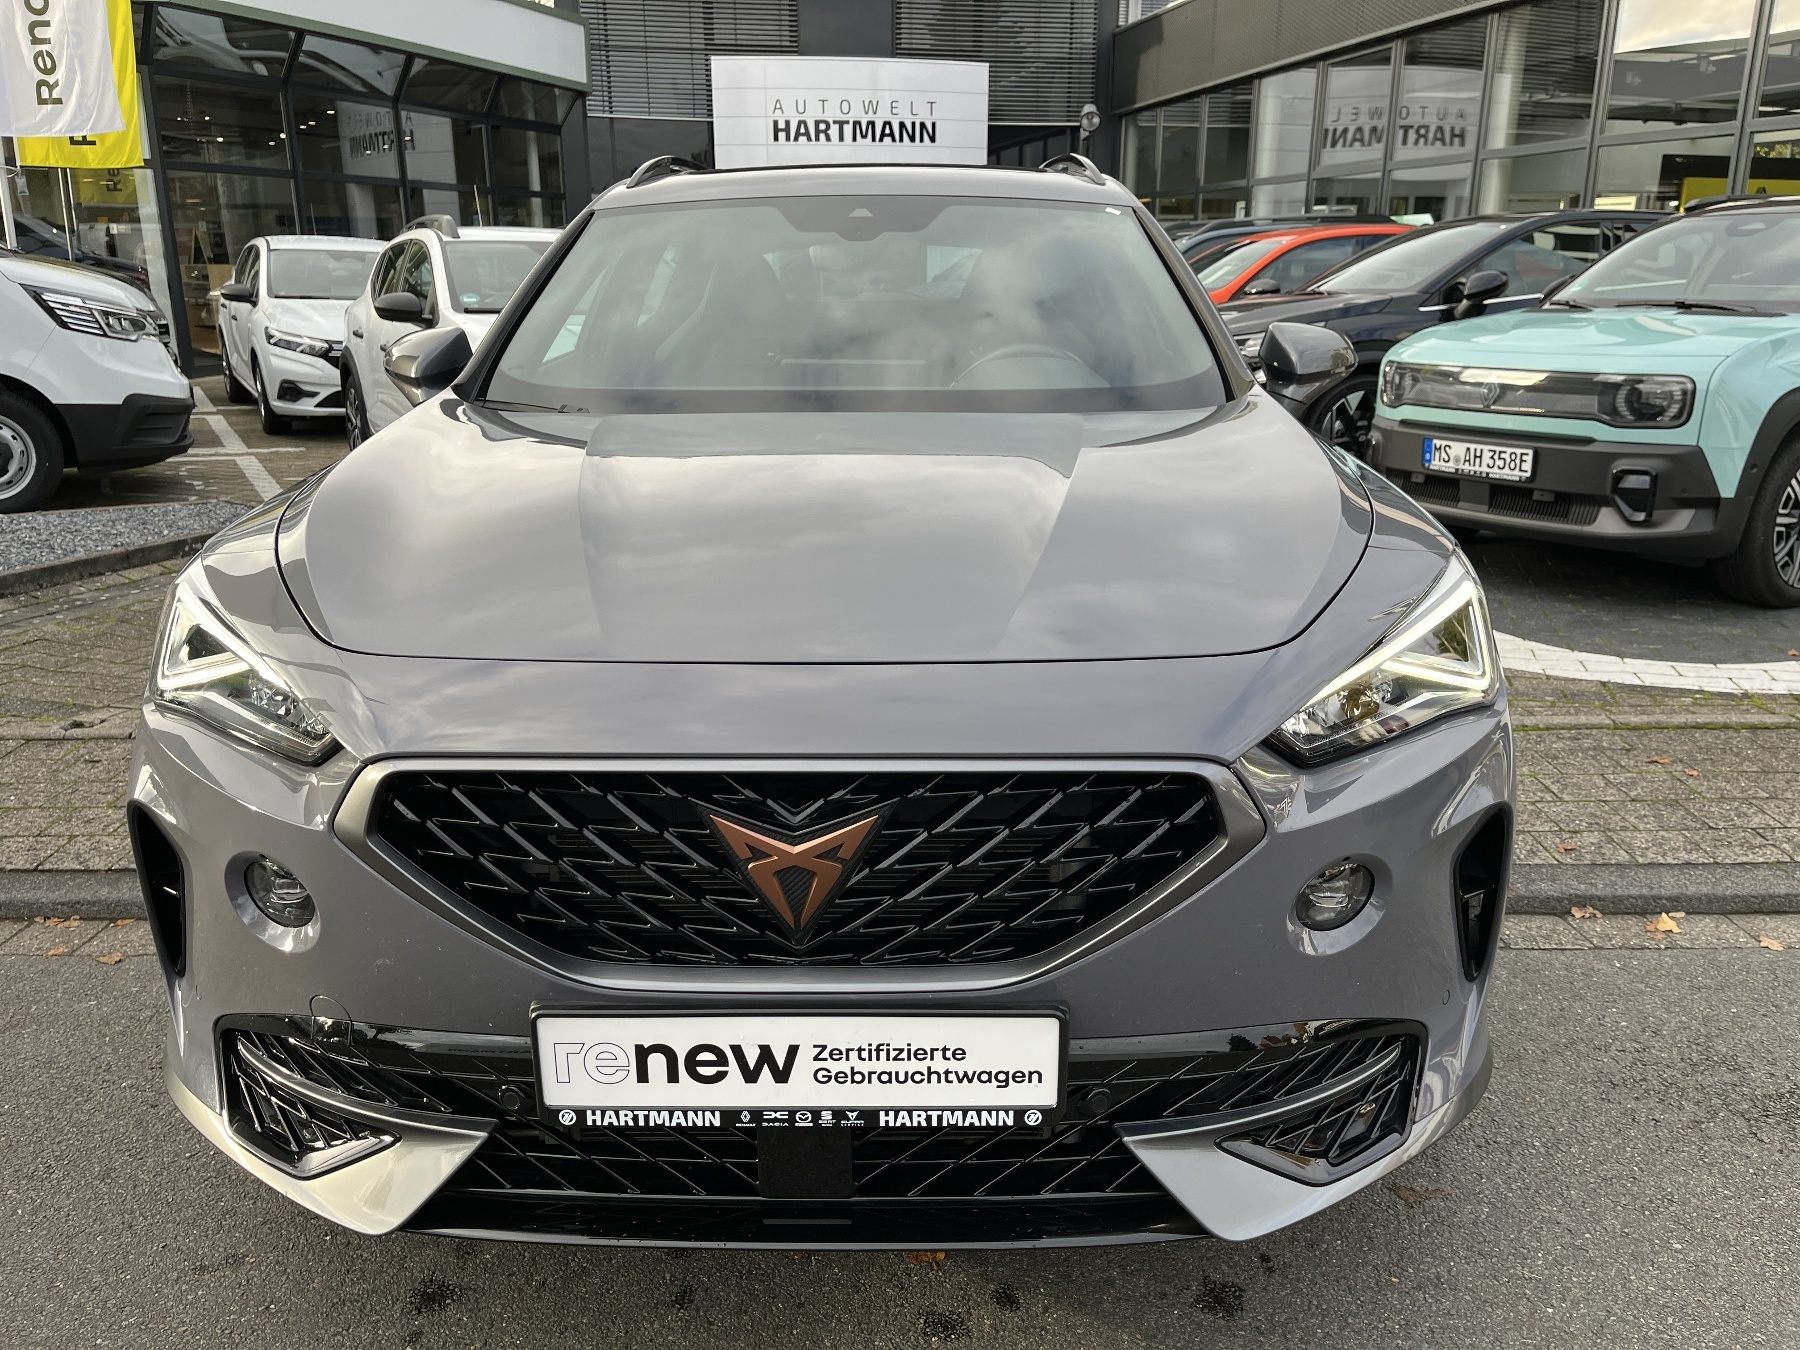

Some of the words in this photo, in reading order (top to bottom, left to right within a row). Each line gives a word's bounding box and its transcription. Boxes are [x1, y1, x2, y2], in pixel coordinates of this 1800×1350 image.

[772, 99, 937, 117] AUTOWELT
[772, 119, 937, 144] HARTMANN
[1433, 443, 1452, 463] MS
[1463, 447, 1483, 468] AH
[1486, 449, 1530, 473] 358E
[553, 1042, 801, 1085] renew
[812, 1042, 967, 1063] Zertifizierte
[812, 1066, 1043, 1089] Gebrauchtwagen
[586, 1109, 721, 1127] HARTMANN
[879, 1109, 1014, 1127] HARTMANN
